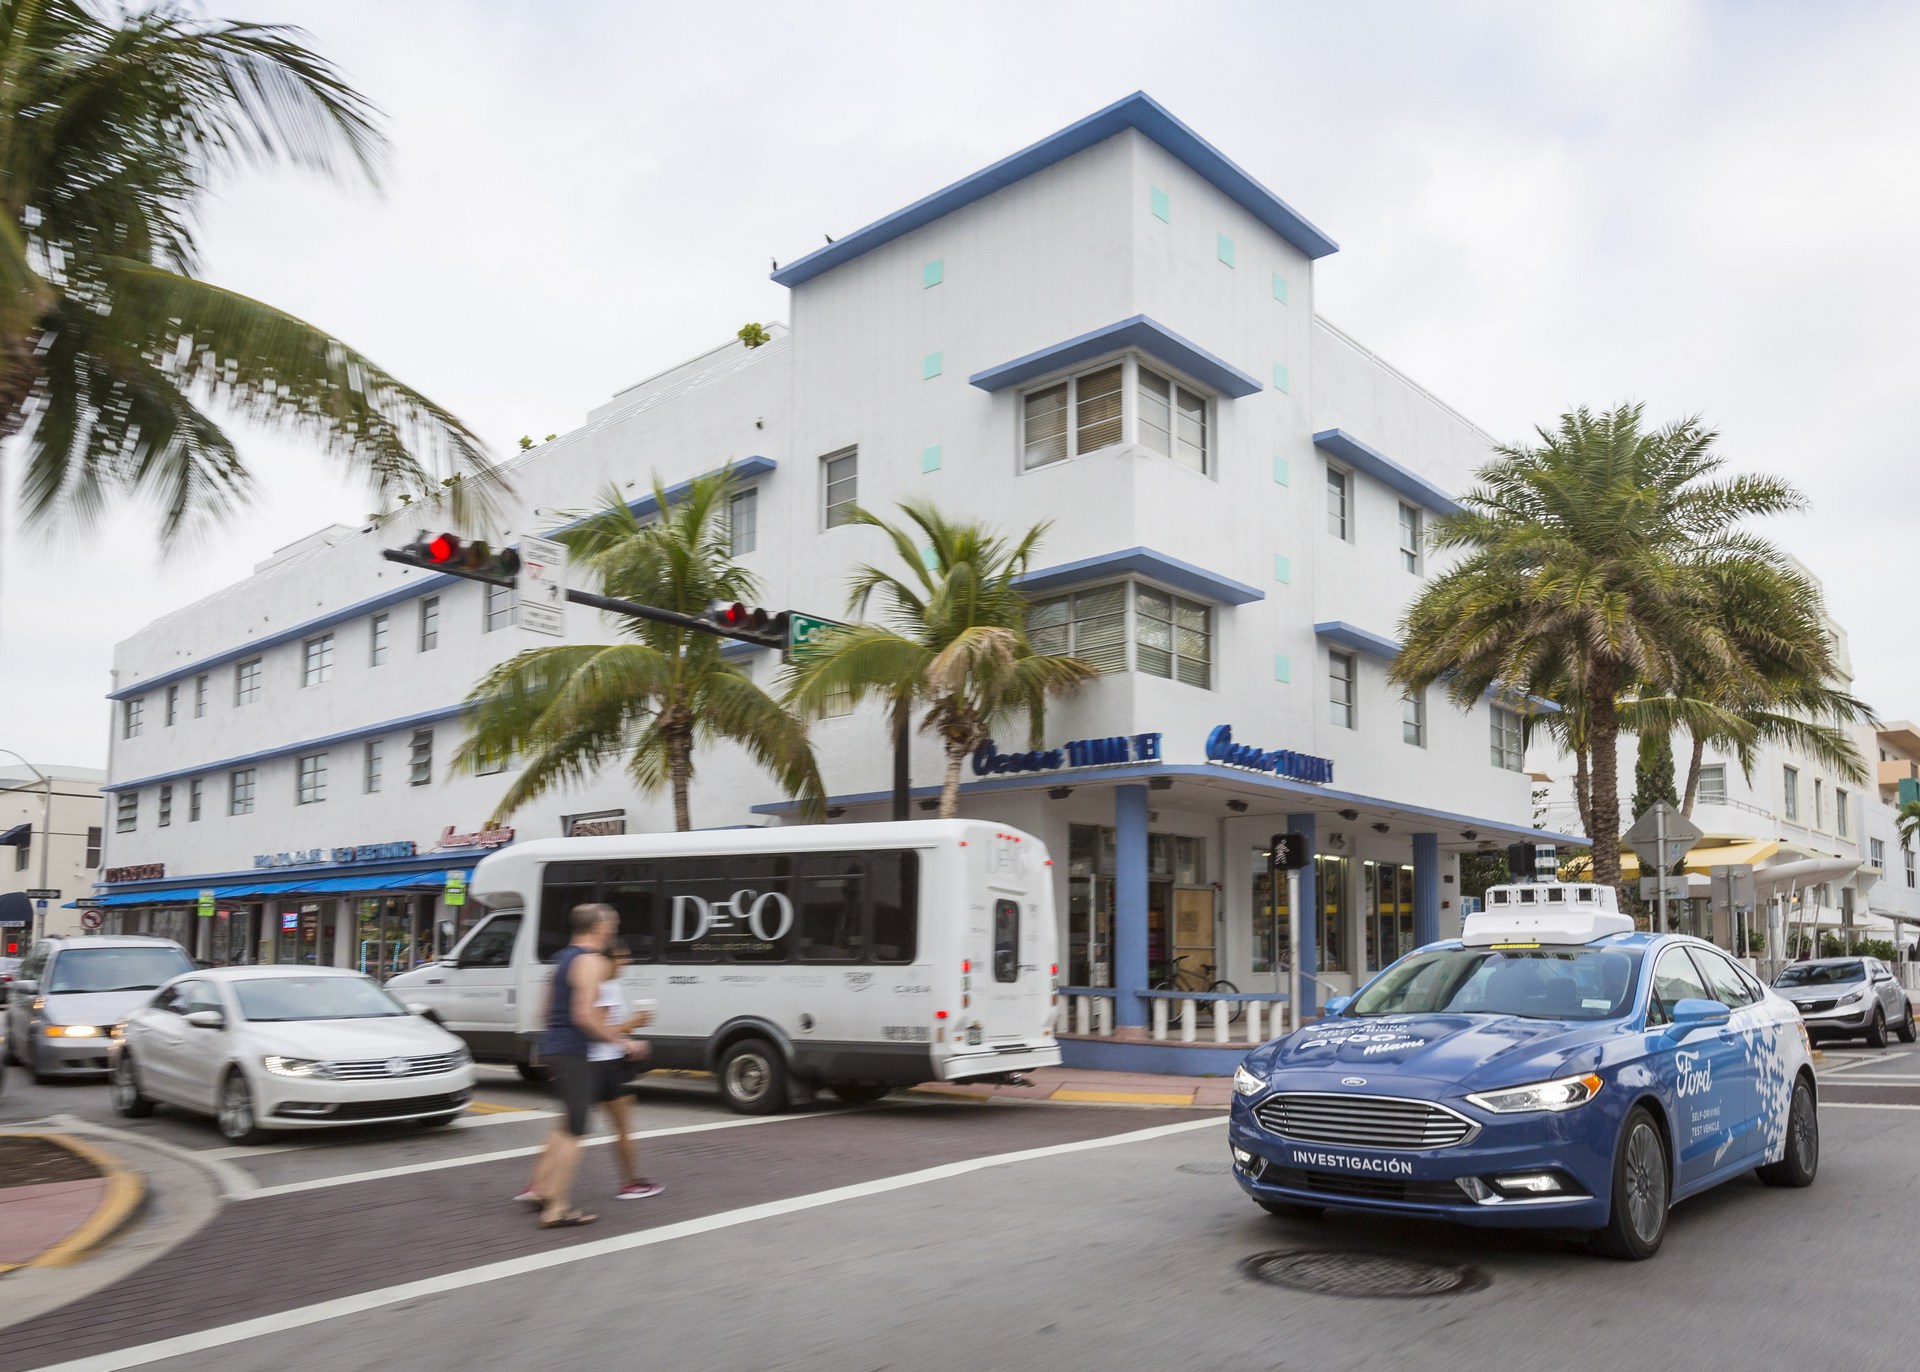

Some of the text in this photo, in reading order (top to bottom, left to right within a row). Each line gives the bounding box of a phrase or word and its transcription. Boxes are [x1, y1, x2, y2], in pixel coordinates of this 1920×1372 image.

[1675, 1050, 1712, 1098] Ford
[1691, 1106, 1720, 1122] SELF-DRIVING
[1691, 1121, 1720, 1137] TEST VEHICLE
[1293, 1150, 1412, 1175] INVESTIGACIÓN
